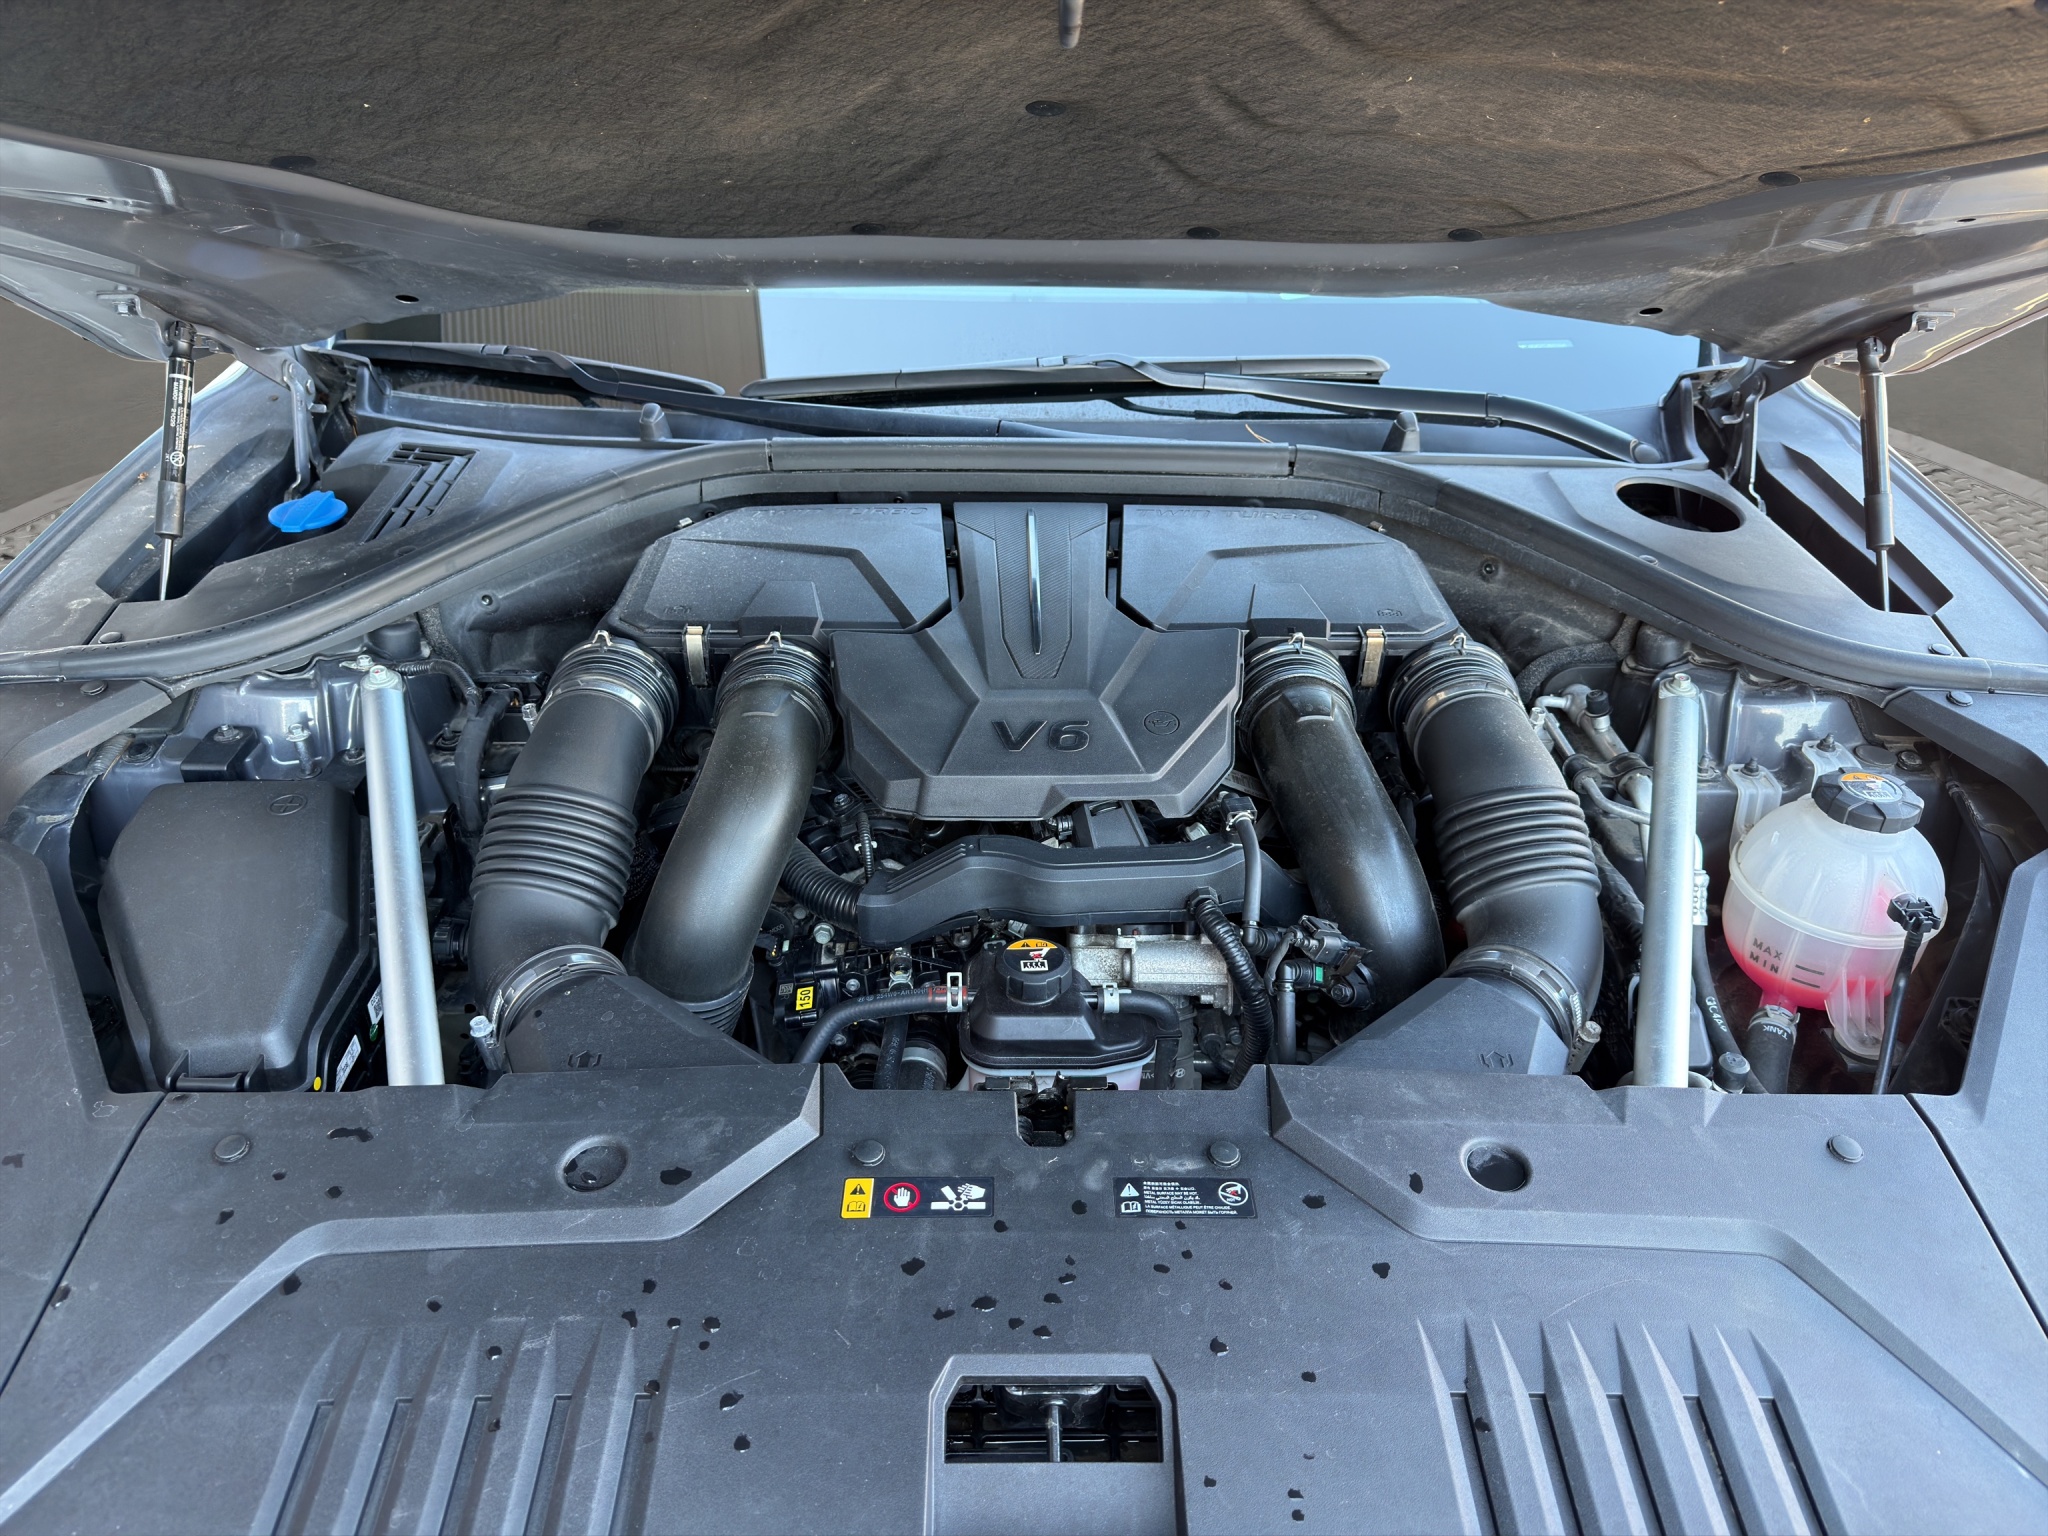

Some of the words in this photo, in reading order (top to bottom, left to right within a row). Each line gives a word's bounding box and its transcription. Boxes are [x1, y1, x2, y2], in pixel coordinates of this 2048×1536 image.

[835, 507, 927, 515] TURBO
[1136, 508, 1210, 518] TWIN
[1219, 509, 1319, 521] TURBO
[991, 719, 1090, 752] V6
[1753, 938, 1782, 960] MAX
[1749, 951, 1779, 974] MIN
[800, 989, 811, 1008] 150
[1763, 1025, 1787, 1040] TANK
